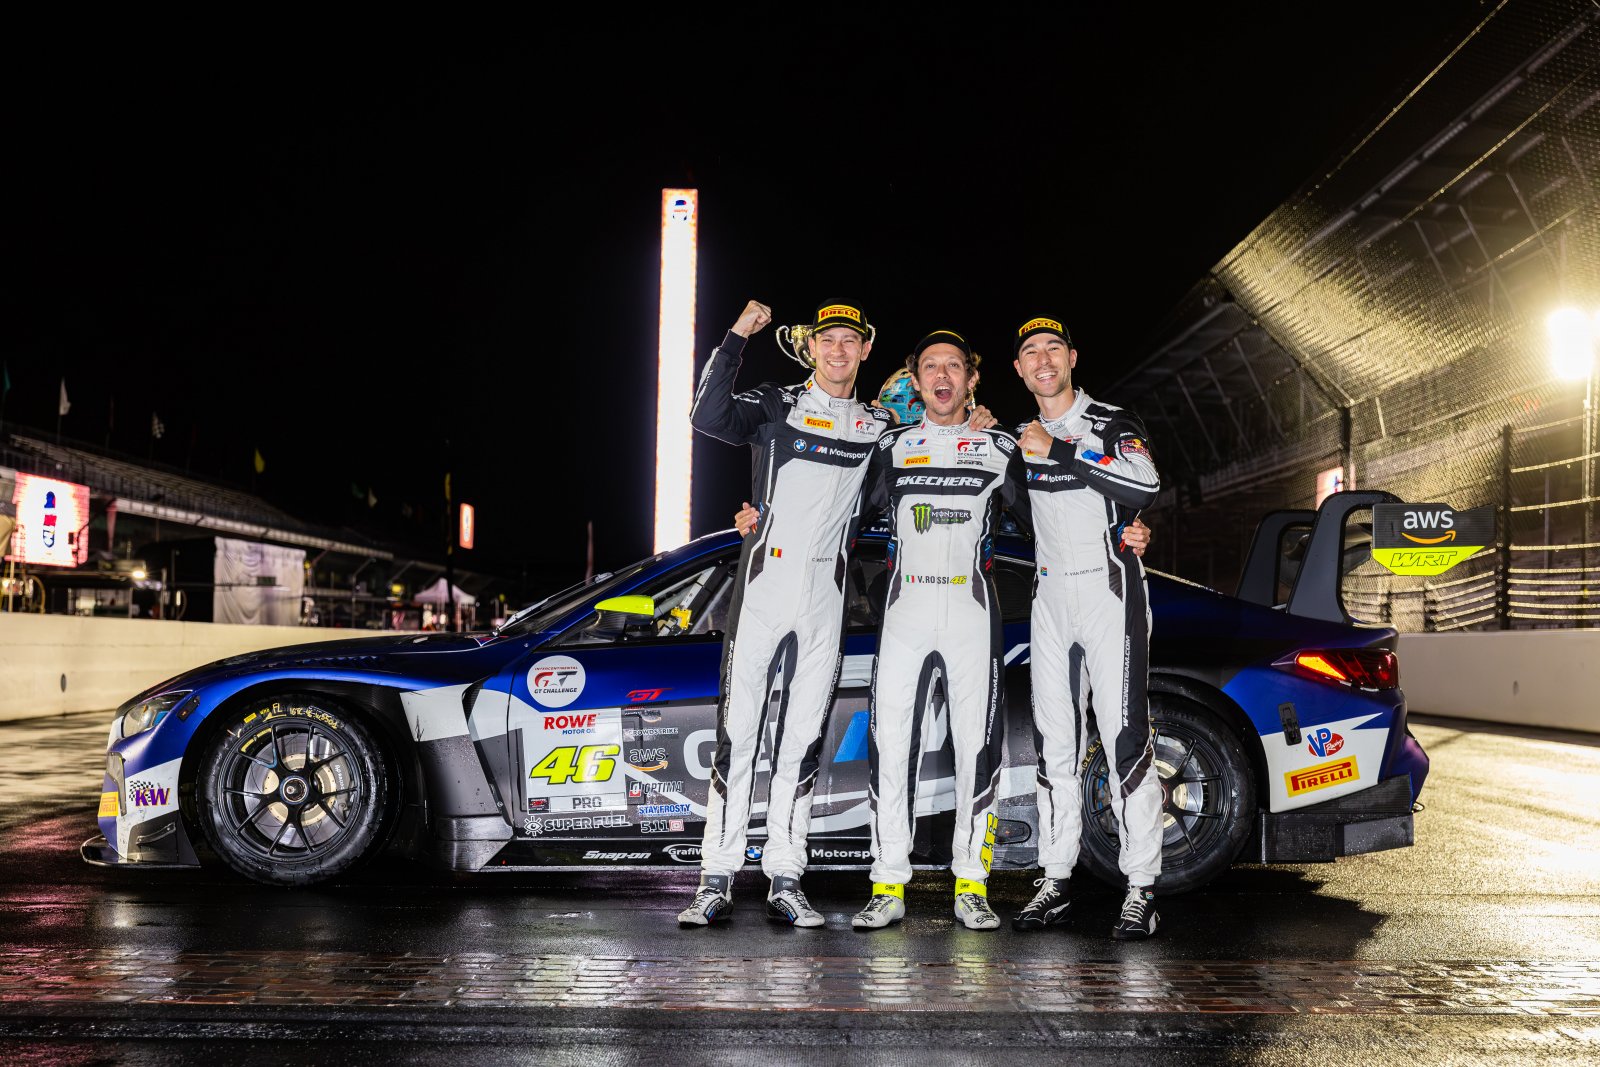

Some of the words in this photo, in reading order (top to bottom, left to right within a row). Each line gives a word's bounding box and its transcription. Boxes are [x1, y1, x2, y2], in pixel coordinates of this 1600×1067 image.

[879, 435, 894, 449] OMP
[997, 437, 1015, 450] OMP
[829, 448, 867, 460] Motorsport
[896, 475, 984, 488] SKECHERS
[1403, 511, 1454, 529] aws
[1390, 551, 1457, 567] WRT
[950, 575, 967, 585] 46
[1122, 634, 1131, 728] W-RACINGTEAM.COM
[543, 714, 597, 731] ROWE
[1307, 728, 1331, 757] VP
[630, 747, 666, 763] aws
[530, 744, 620, 785] 46
[1291, 761, 1353, 791] PIRELLI
[643, 780, 682, 795] OPTIMA
[135, 788, 170, 807] KW
[572, 796, 602, 809] PRO
[639, 805, 658, 815] STAY
[660, 803, 691, 813] FROSTY
[544, 816, 592, 832] SUPER
[592, 814, 633, 829] FUEL
[640, 820, 669, 834] 5.11
[582, 850, 652, 860] Snap-on
[811, 848, 872, 859] Motorsp
